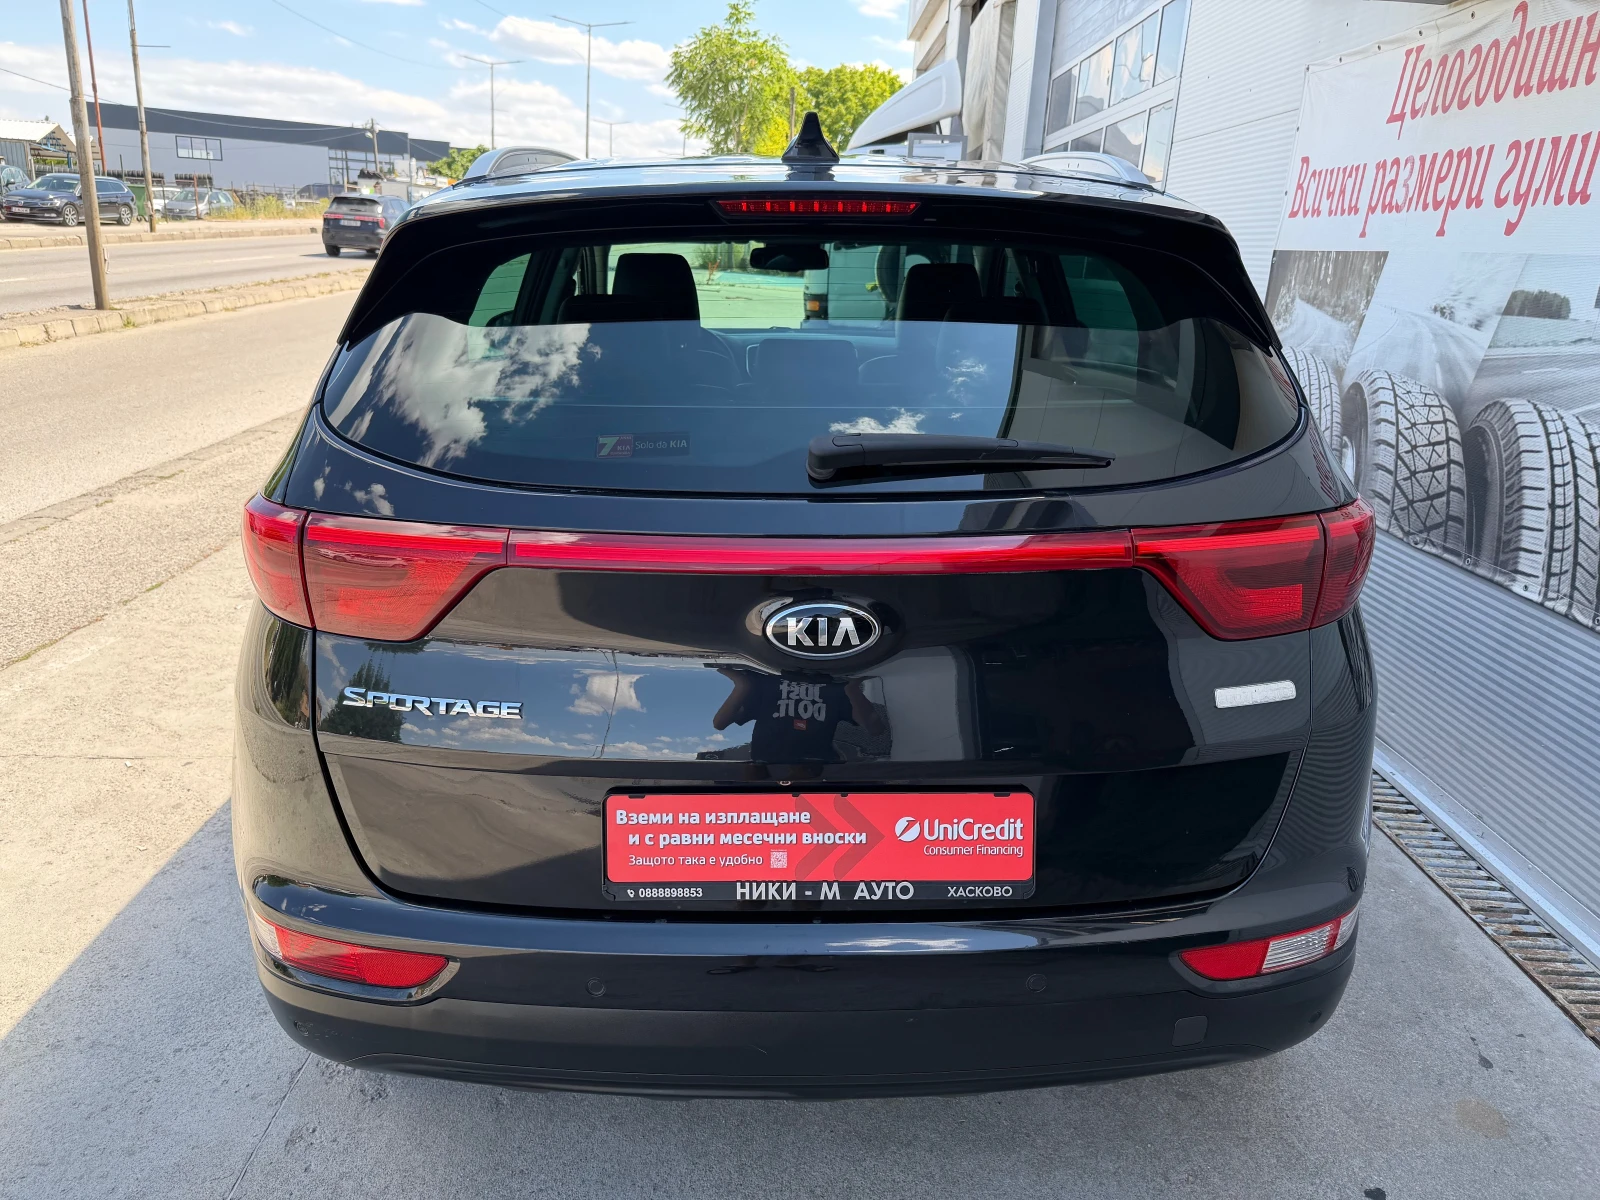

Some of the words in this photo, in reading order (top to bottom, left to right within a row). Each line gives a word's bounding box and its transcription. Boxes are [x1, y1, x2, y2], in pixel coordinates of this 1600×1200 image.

[1386, 0, 1600, 140] Целогодишн
[1288, 155, 1367, 219] Всички
[1358, 143, 1495, 238] размери
[1494, 130, 1600, 237] гуми
[599, 437, 620, 456] 7
[635, 441, 654, 450] Solo
[656, 440, 667, 449] da
[669, 439, 688, 448] KIA
[786, 617, 861, 647] KIA
[342, 686, 524, 720] SPORTAGE
[616, 809, 674, 826] Вземи
[678, 812, 700, 825] на
[705, 810, 811, 827] изплащане
[923, 817, 1024, 841] UniCredit
[628, 833, 640, 845] и
[644, 833, 655, 845] с
[659, 833, 715, 848] равни
[719, 832, 797, 845] месечни
[801, 831, 867, 845] вноски
[923, 844, 974, 856] Consumer
[976, 844, 1024, 858] Financing
[628, 854, 675, 867] Защото
[678, 855, 706, 865] така
[709, 856, 716, 865] е
[719, 854, 763, 867] удобно
[638, 887, 703, 898] 0888898853
[736, 881, 797, 900] НИКИ
[819, 881, 841, 900] М
[853, 881, 914, 900] АУТО
[947, 885, 1013, 898] ХАСКОВО
